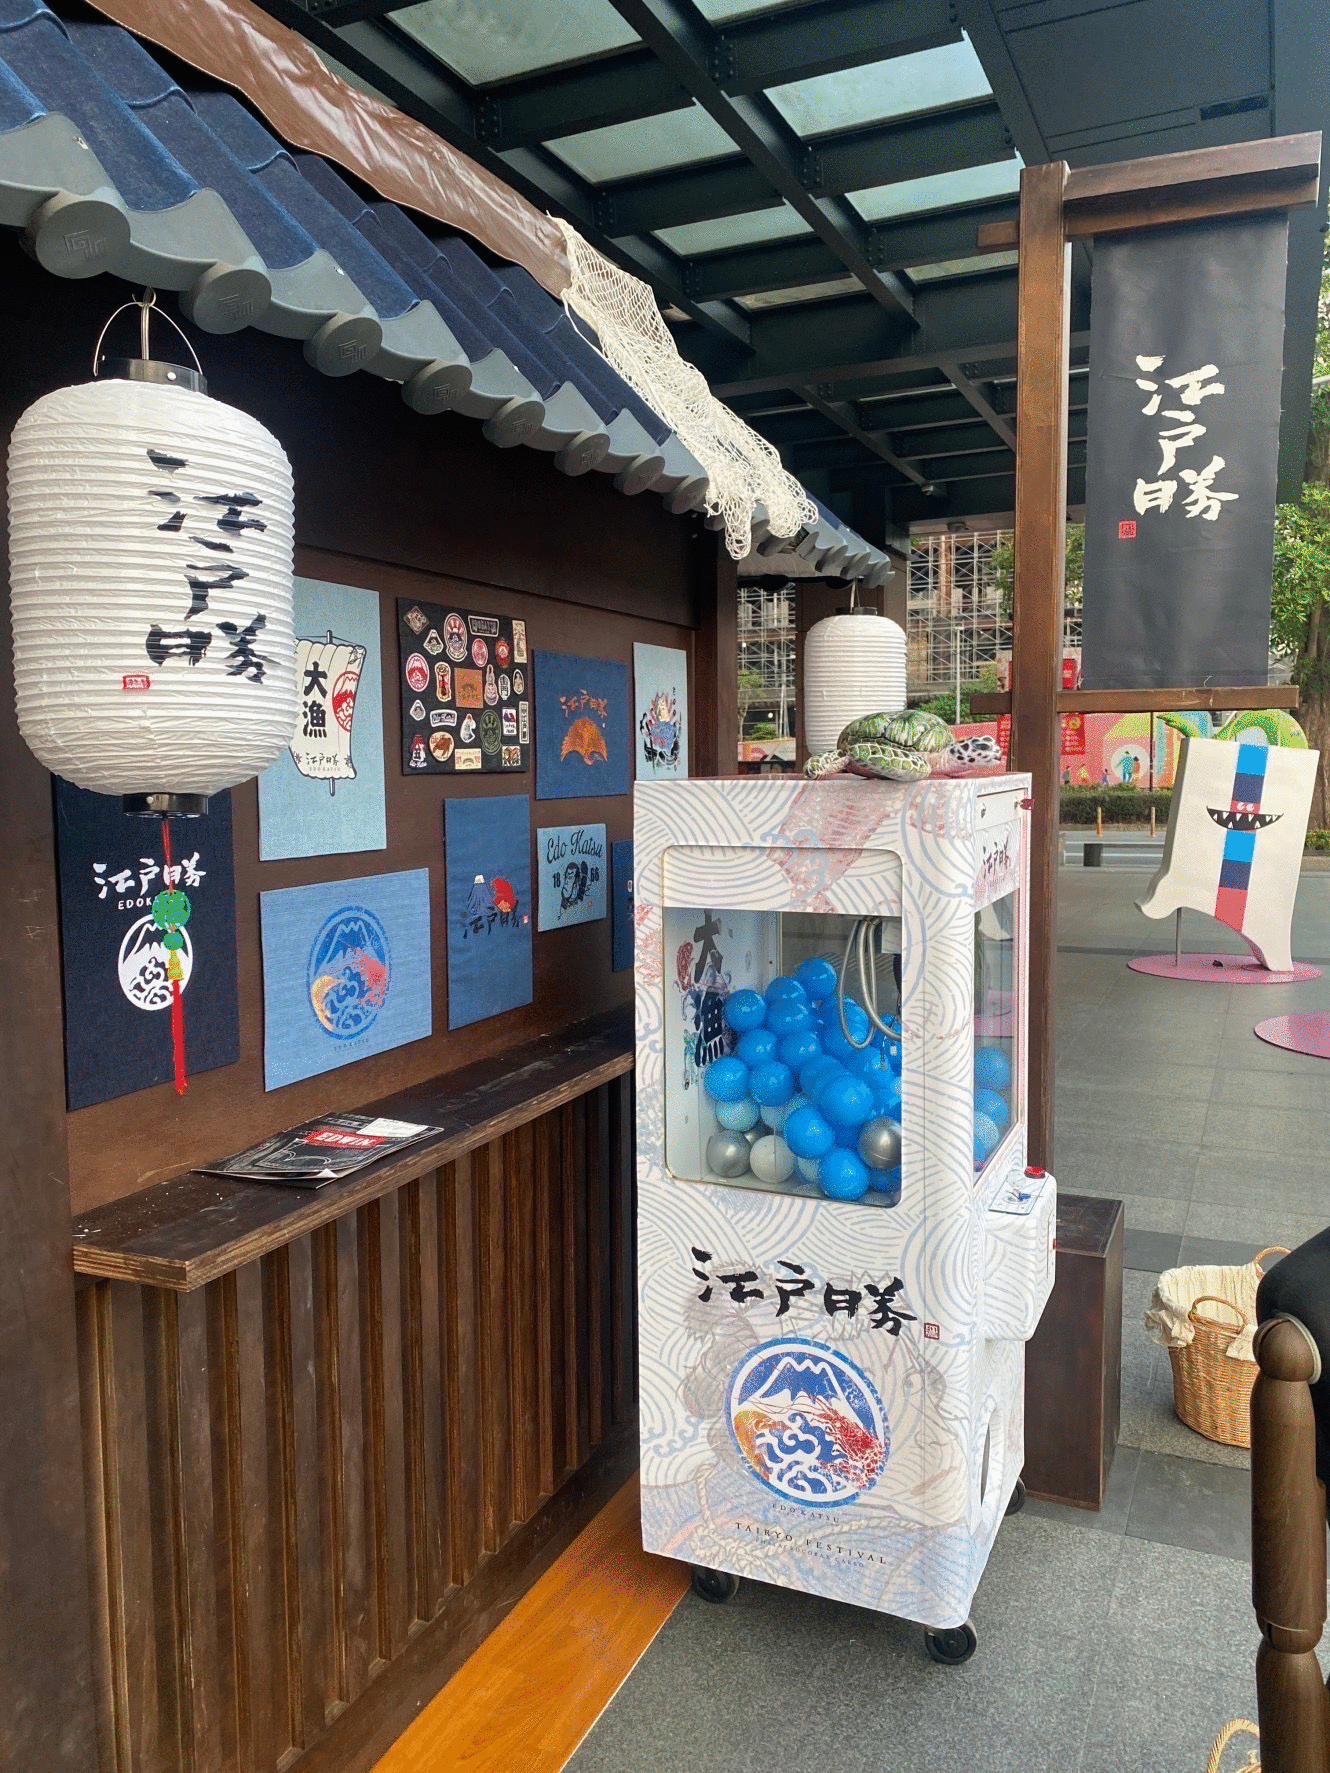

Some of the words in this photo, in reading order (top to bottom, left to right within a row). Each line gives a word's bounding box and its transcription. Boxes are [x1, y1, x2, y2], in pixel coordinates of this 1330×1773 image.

[1133, 355, 1240, 522] 江戸勝
[302, 661, 328, 739] 大漁
[546, 834, 568, 864] Edo
[570, 829, 603, 858] Katsu
[92, 851, 207, 899] 江戸勝
[552, 872, 561, 889] 18
[314, 1131, 377, 1147] EDWIN
[691, 1246, 918, 1337] 江戸勝
[735, 1521, 793, 1542] TAIRYO
[806, 1538, 887, 1565] FESTIVAL
